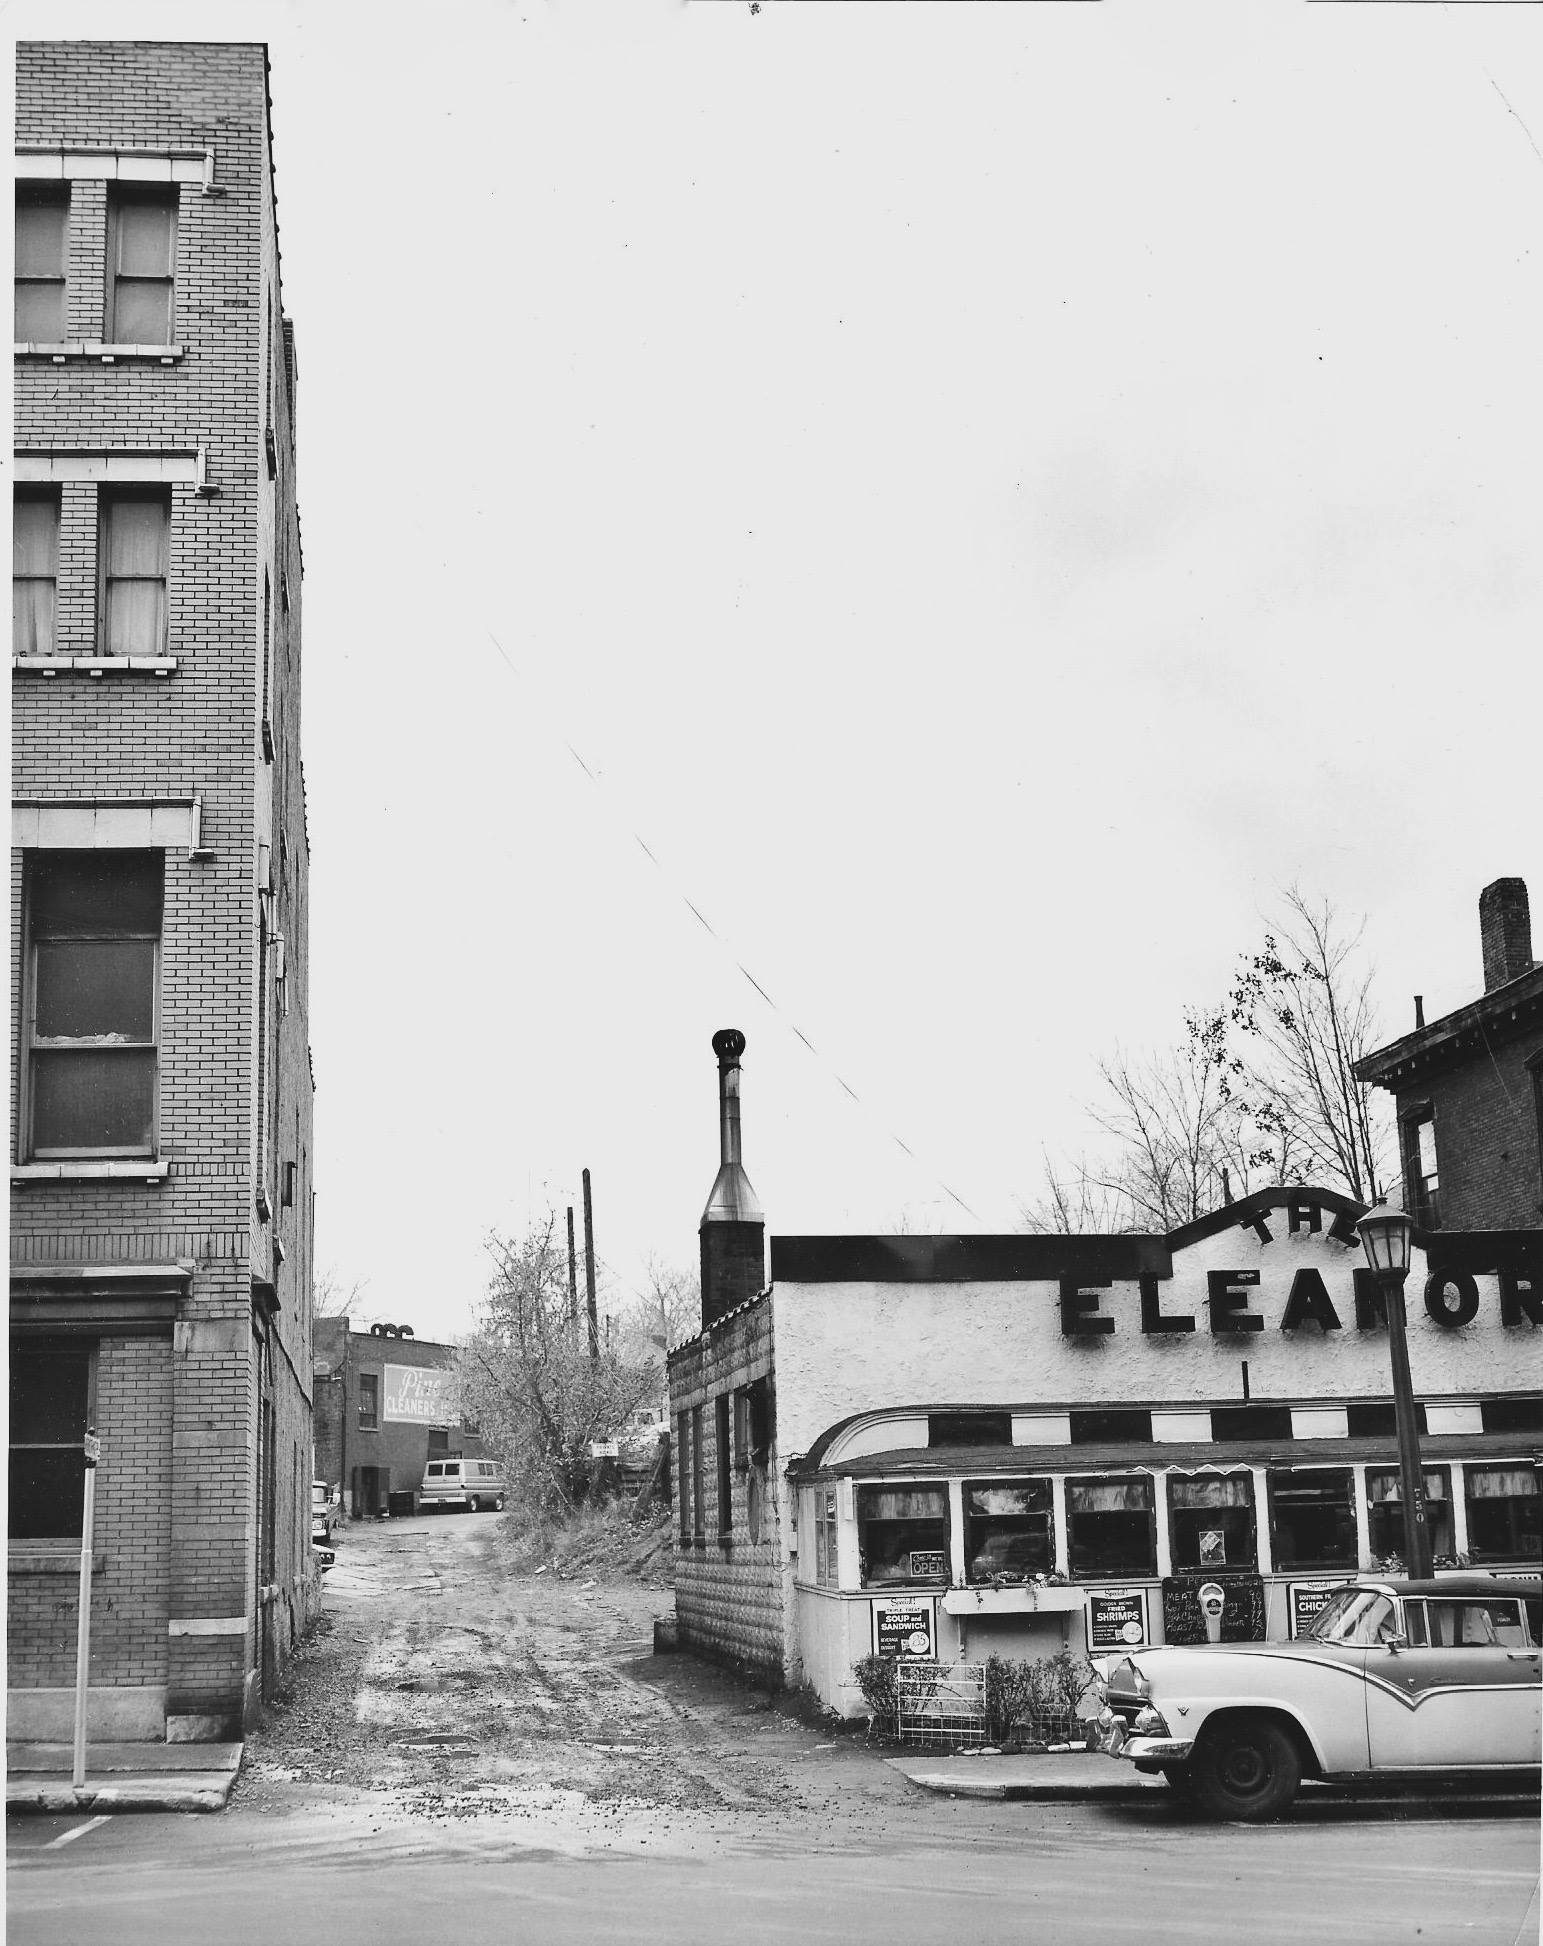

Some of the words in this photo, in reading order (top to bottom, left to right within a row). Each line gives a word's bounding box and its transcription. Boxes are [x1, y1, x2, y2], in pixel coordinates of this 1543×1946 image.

[1239, 1199, 1362, 1249] THE
[386, 1396, 436, 1417] CLEANERS
[914, 1562, 944, 1574] OPEN
[1167, 1591, 1194, 1601] MEAT
[1298, 1601, 1328, 1611] CHICK
[885, 1615, 910, 1623] SOUP
[1096, 1610, 1139, 1621] SHRIMPS
[881, 1622, 926, 1631] SANDWICH
